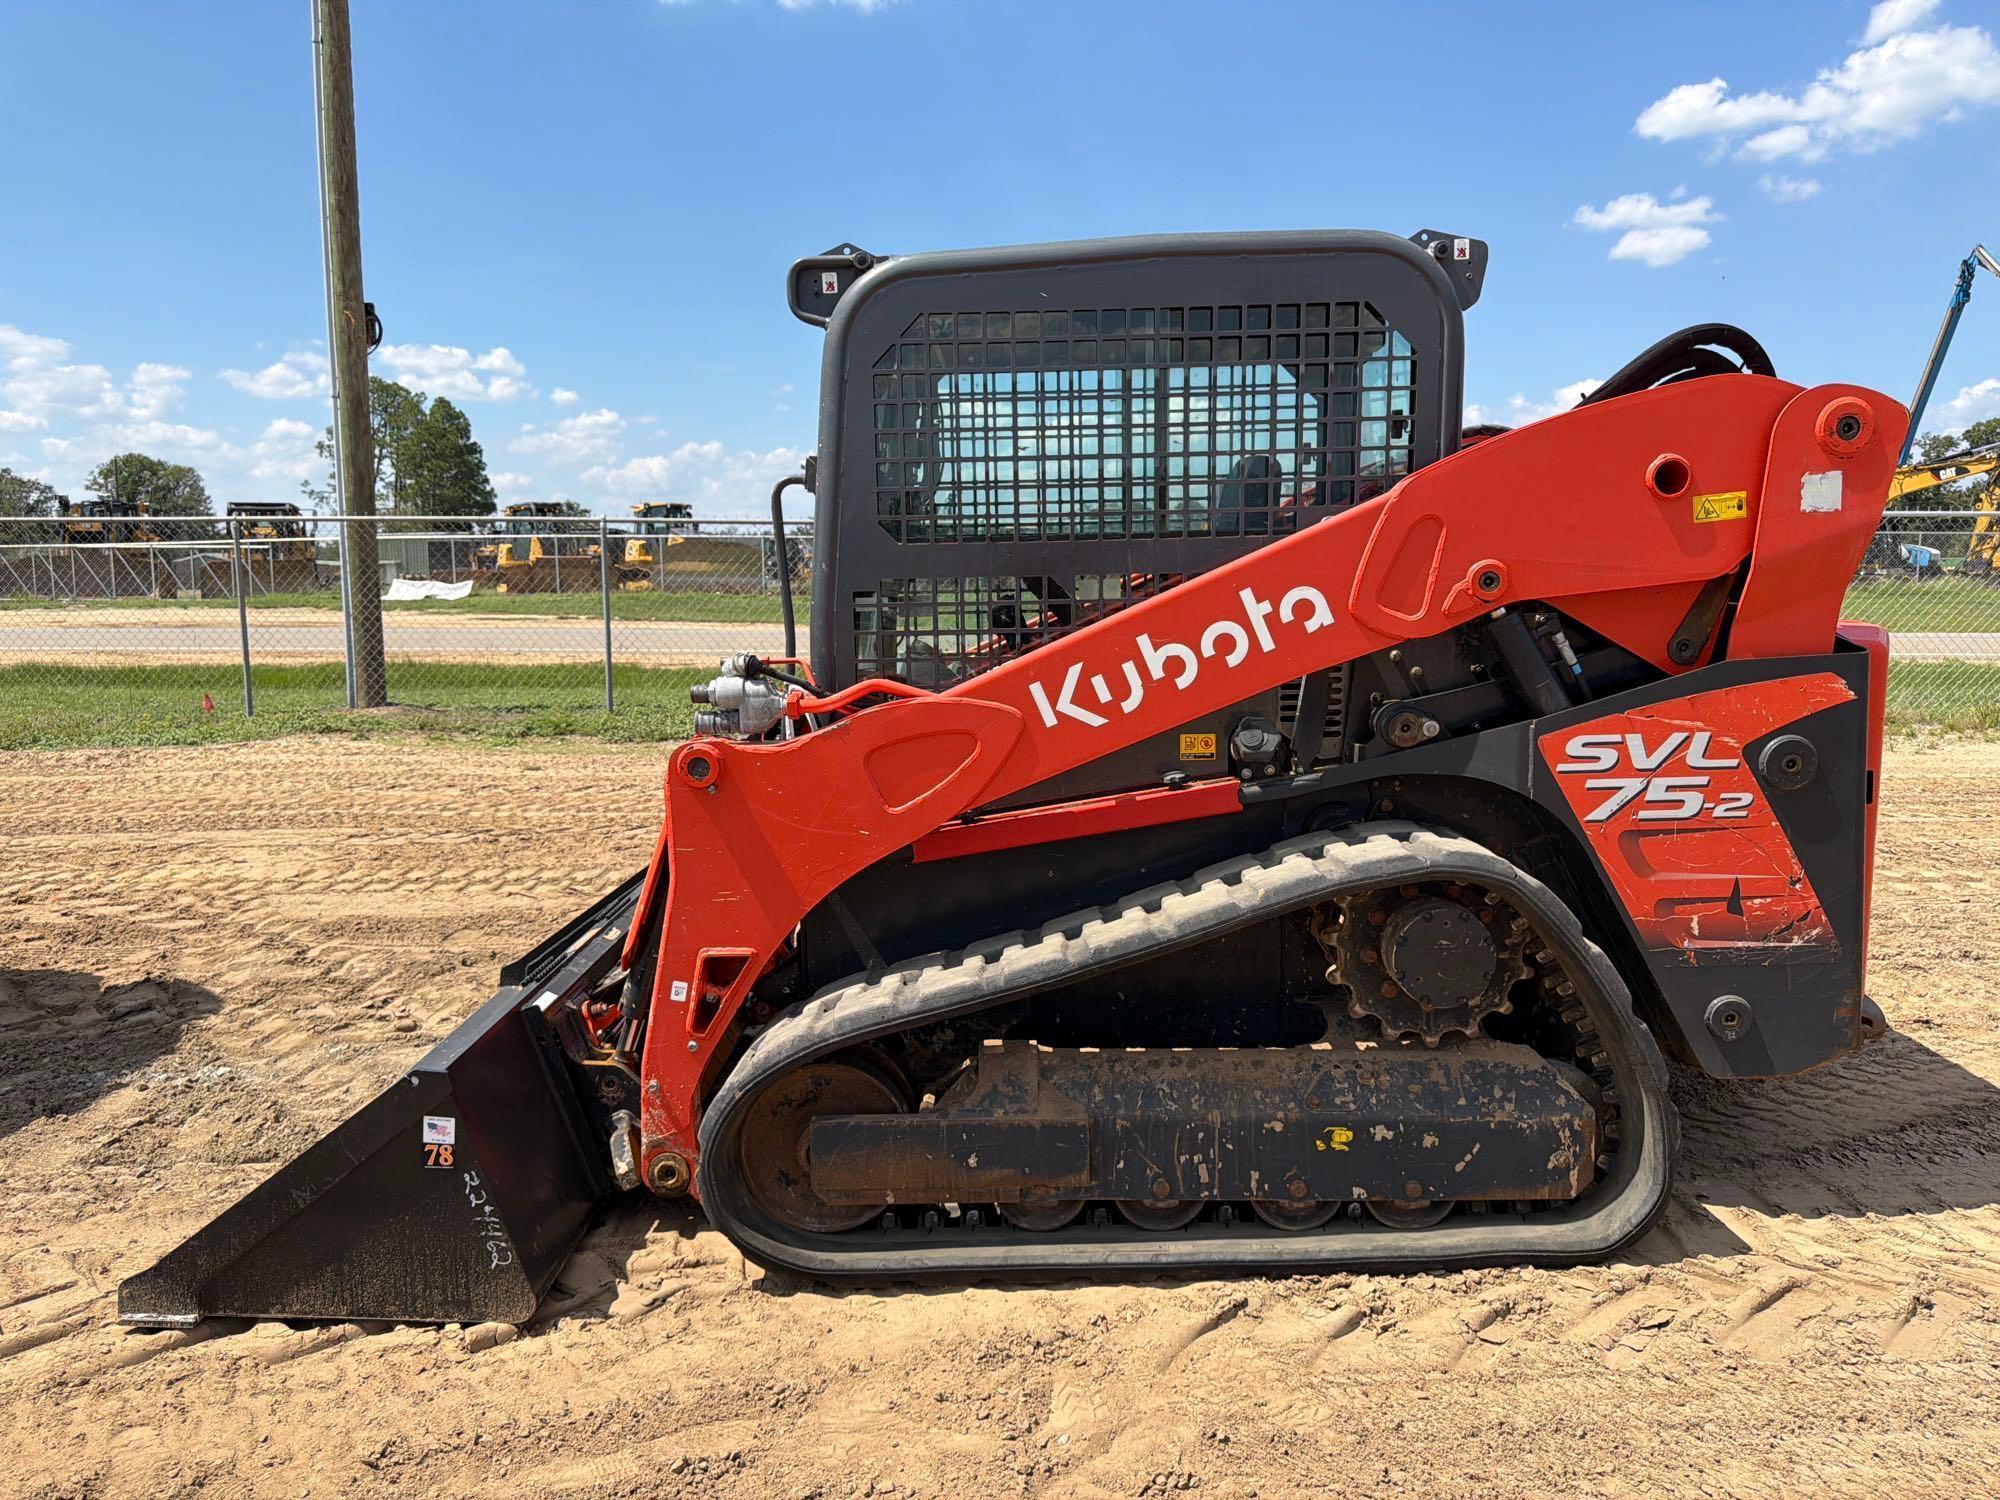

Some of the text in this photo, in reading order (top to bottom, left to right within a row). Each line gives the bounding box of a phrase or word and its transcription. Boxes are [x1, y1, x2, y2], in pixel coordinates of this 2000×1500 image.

[1940, 467, 1957, 480] CAT
[1028, 586, 1335, 728] Kubota
[1556, 732, 1741, 774] SVL
[1583, 776, 1754, 822] 75-2
[424, 1144, 454, 1166] 78
